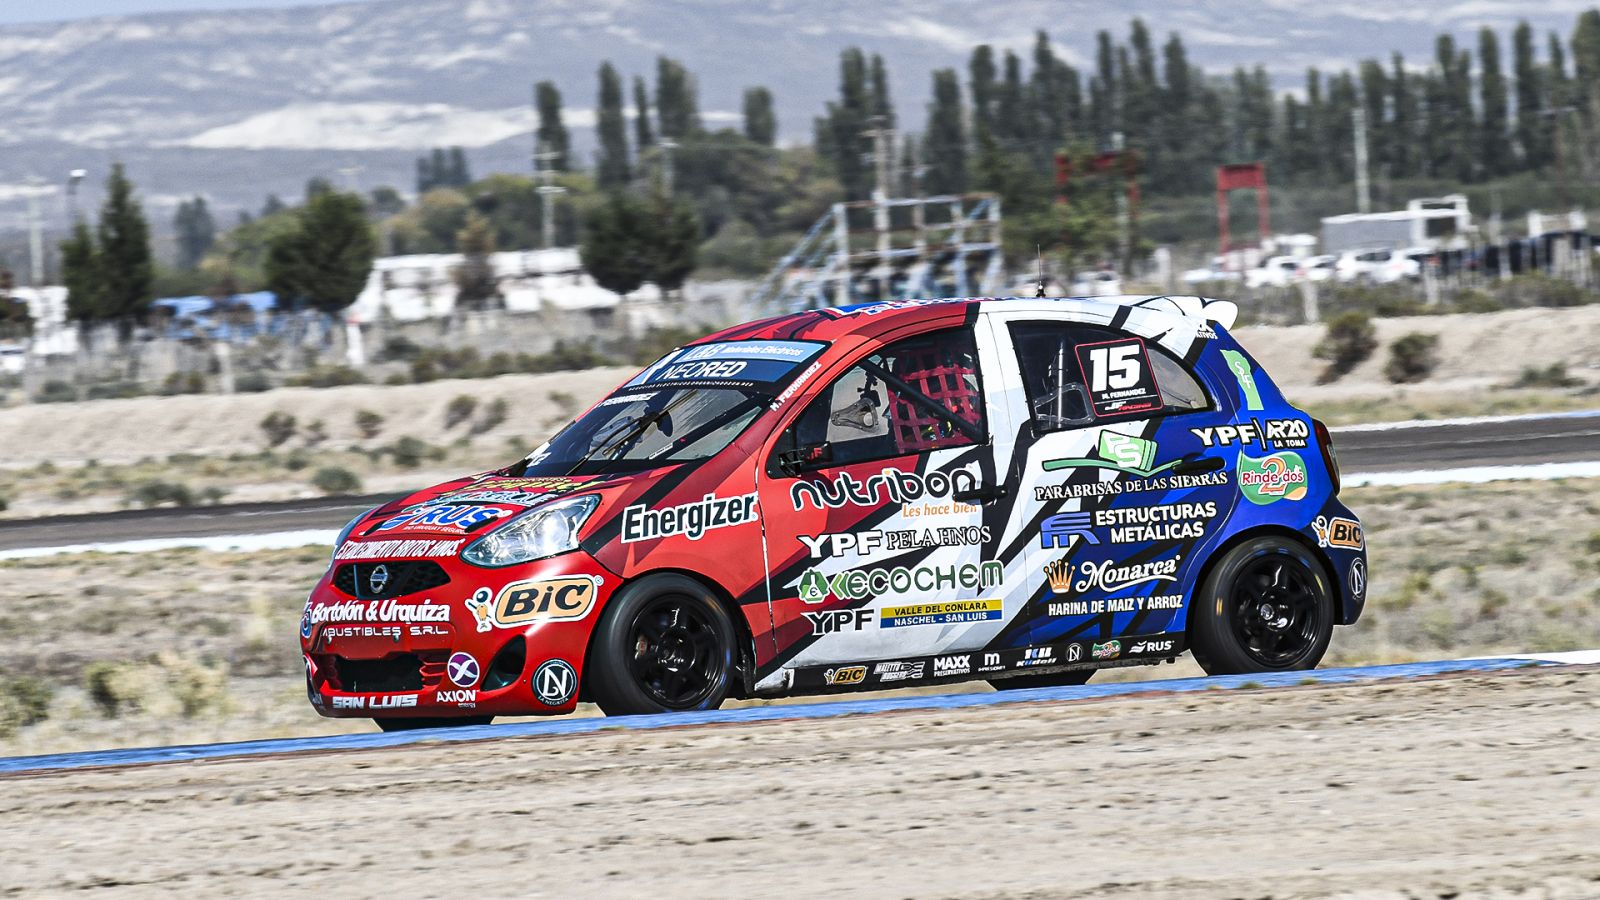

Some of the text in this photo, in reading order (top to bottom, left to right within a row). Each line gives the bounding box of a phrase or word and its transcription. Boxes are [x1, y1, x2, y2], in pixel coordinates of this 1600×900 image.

[656, 361, 747, 380] NEORED
[1090, 344, 1141, 392] 15
[1110, 387, 1147, 399] FERNANDEZ
[1191, 425, 1256, 446] YPF
[1274, 439, 1306, 448] LA TOMA
[1036, 472, 1228, 500] PARABRISAS DE LAS SIERRAS
[1242, 470, 1304, 484] Rinde dos
[792, 468, 977, 508] nutribon
[411, 504, 500, 531] RUS
[622, 493, 756, 542] Energizer
[902, 502, 977, 517] Les hace bien
[1095, 502, 1217, 526] ESTRUCTURAS
[1111, 521, 1204, 543] METÁLICAS
[799, 530, 882, 558] YPF
[848, 560, 1003, 598] ECOCHEM
[1076, 557, 1178, 593] Monarca
[312, 600, 364, 624] Bortolón
[366, 600, 378, 622] &
[380, 599, 450, 625] Urquiza
[894, 602, 988, 615] VALLE DEL CONLARA
[1048, 595, 1183, 616] HARINA DE MAIZ Y ARROZ
[806, 608, 874, 635] YPF
[894, 616, 936, 626] NASCHEL
[945, 613, 964, 622] SAN
[967, 612, 988, 621] LUIS
[1147, 641, 1172, 652] RUS
[934, 655, 971, 671] MAXX
[934, 668, 971, 677] PRESERVATIVOS
[332, 696, 365, 709] SAN
[369, 694, 419, 708] LUIS
[436, 690, 477, 703] AXION
